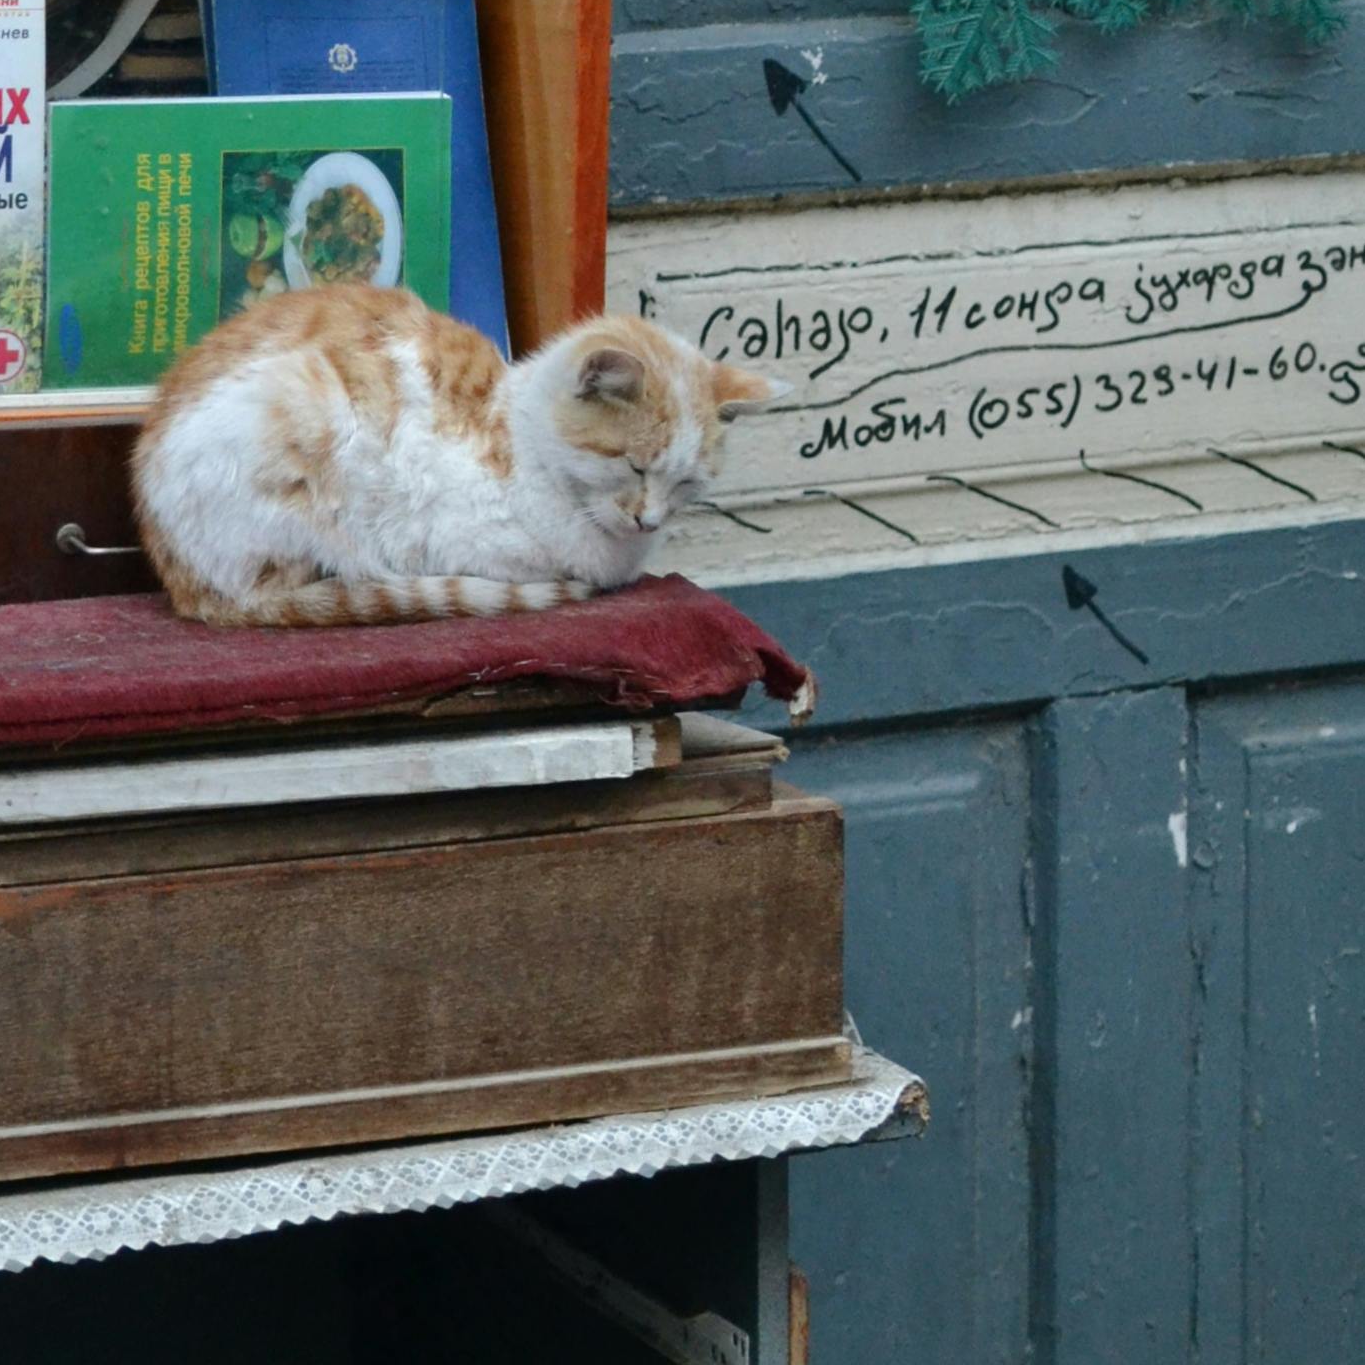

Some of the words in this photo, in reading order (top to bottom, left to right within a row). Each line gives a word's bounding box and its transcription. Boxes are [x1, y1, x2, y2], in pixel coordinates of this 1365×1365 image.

[136, 153, 154, 192] для
[160, 153, 172, 165] в
[178, 153, 192, 197] печи
[156, 169, 176, 217] пищи
[133, 200, 153, 290] рецептов
[153, 222, 172, 354] приготовления
[128, 299, 148, 356] Книга
[799, 397, 946, 460] Мобил
[968, 383, 1083, 439] (055)
